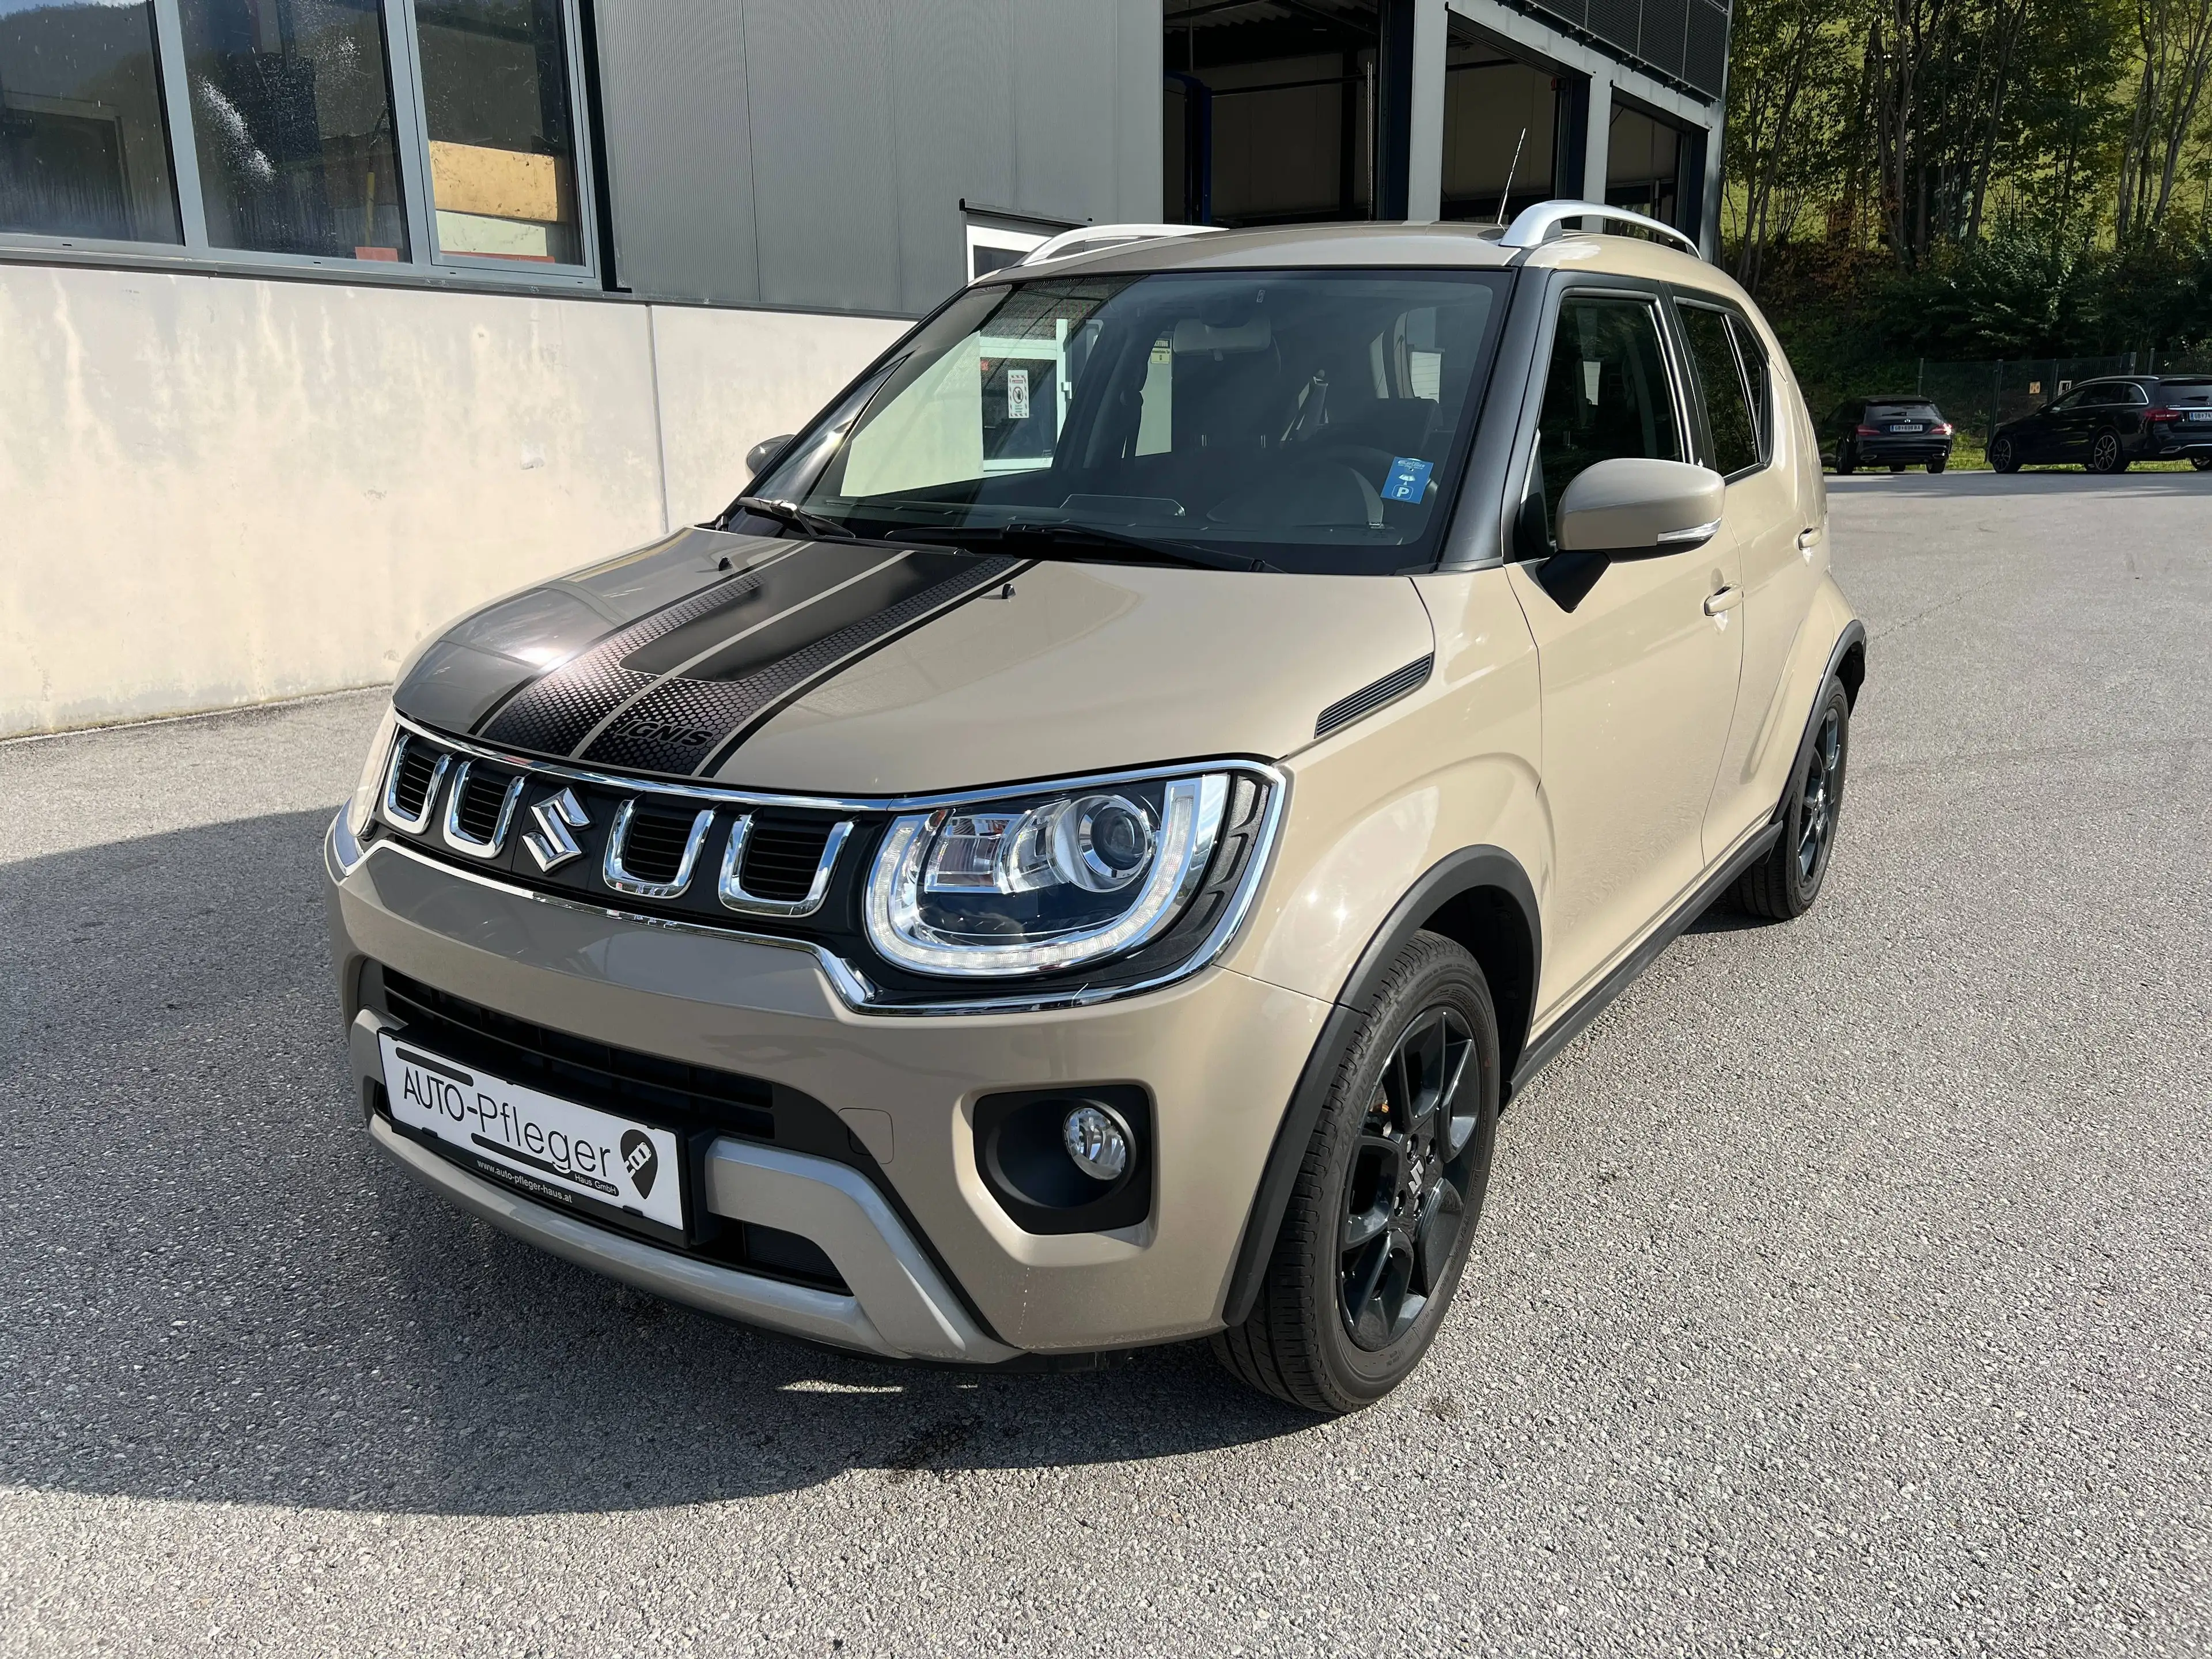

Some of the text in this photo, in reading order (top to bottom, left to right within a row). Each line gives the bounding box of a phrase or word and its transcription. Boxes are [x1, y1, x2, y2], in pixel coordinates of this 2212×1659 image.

[1396, 487, 1410, 497] P
[614, 719, 714, 747] IGNIS
[404, 1066, 611, 1177] AUTO-Pfleger
[477, 1160, 573, 1203] www.auto-pfleger-haus.at
[575, 1174, 616, 1195] Haus GmbH
